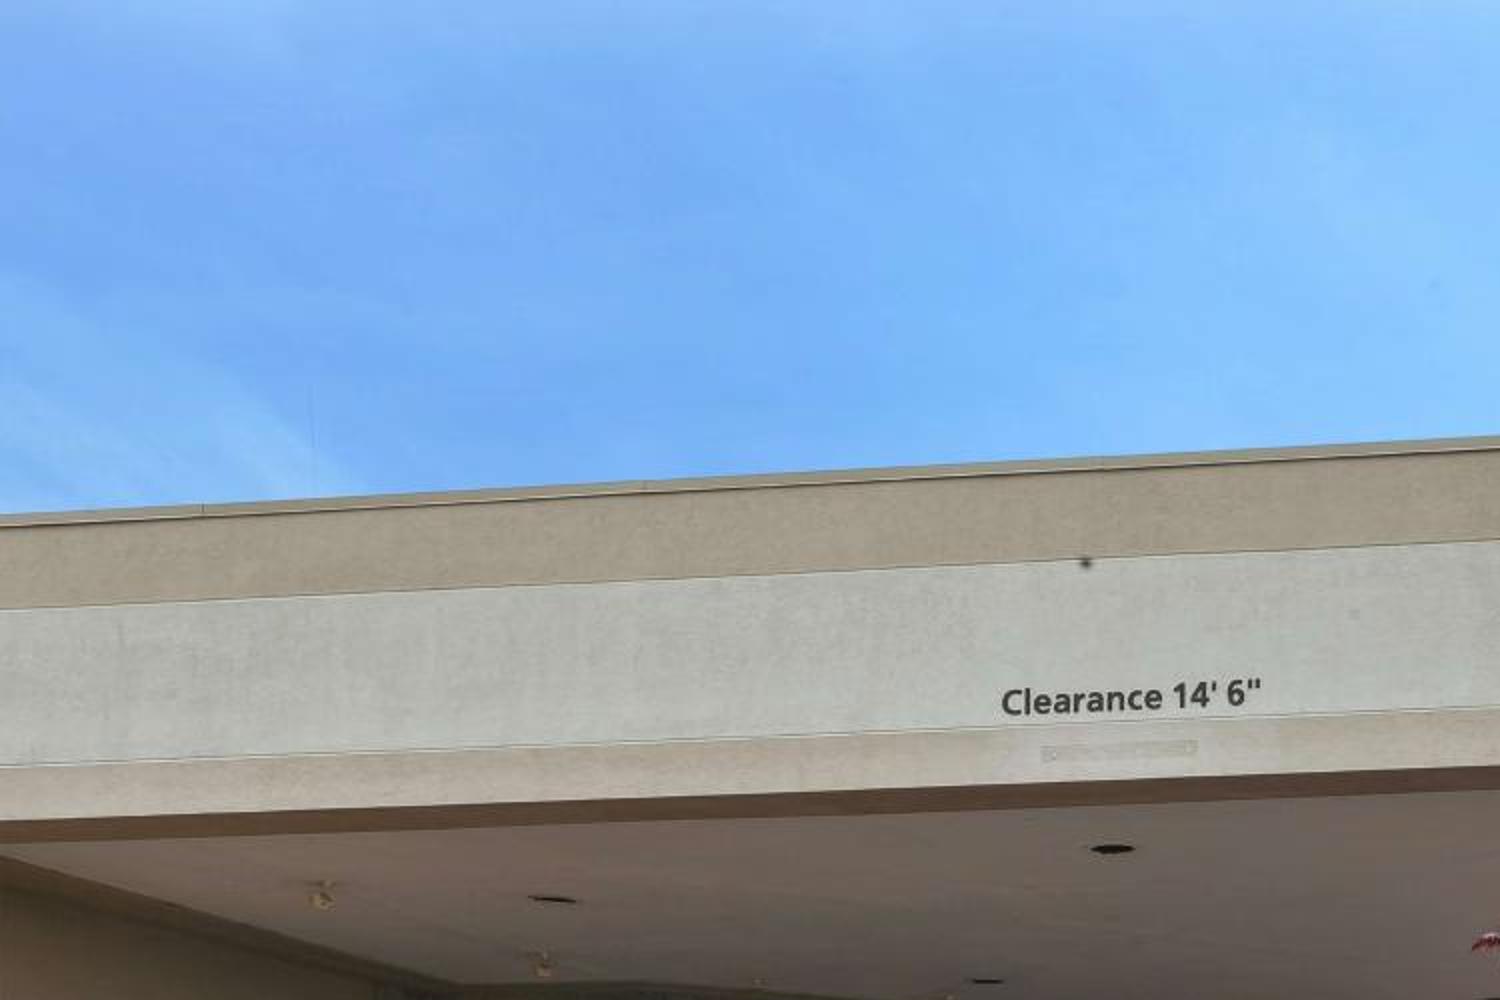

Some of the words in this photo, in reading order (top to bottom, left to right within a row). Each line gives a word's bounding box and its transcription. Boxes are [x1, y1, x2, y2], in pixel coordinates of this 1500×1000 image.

[1000, 687, 1163, 716] Clearance
[1172, 681, 1217, 709] 14'
[1226, 678, 1262, 707] 6"
